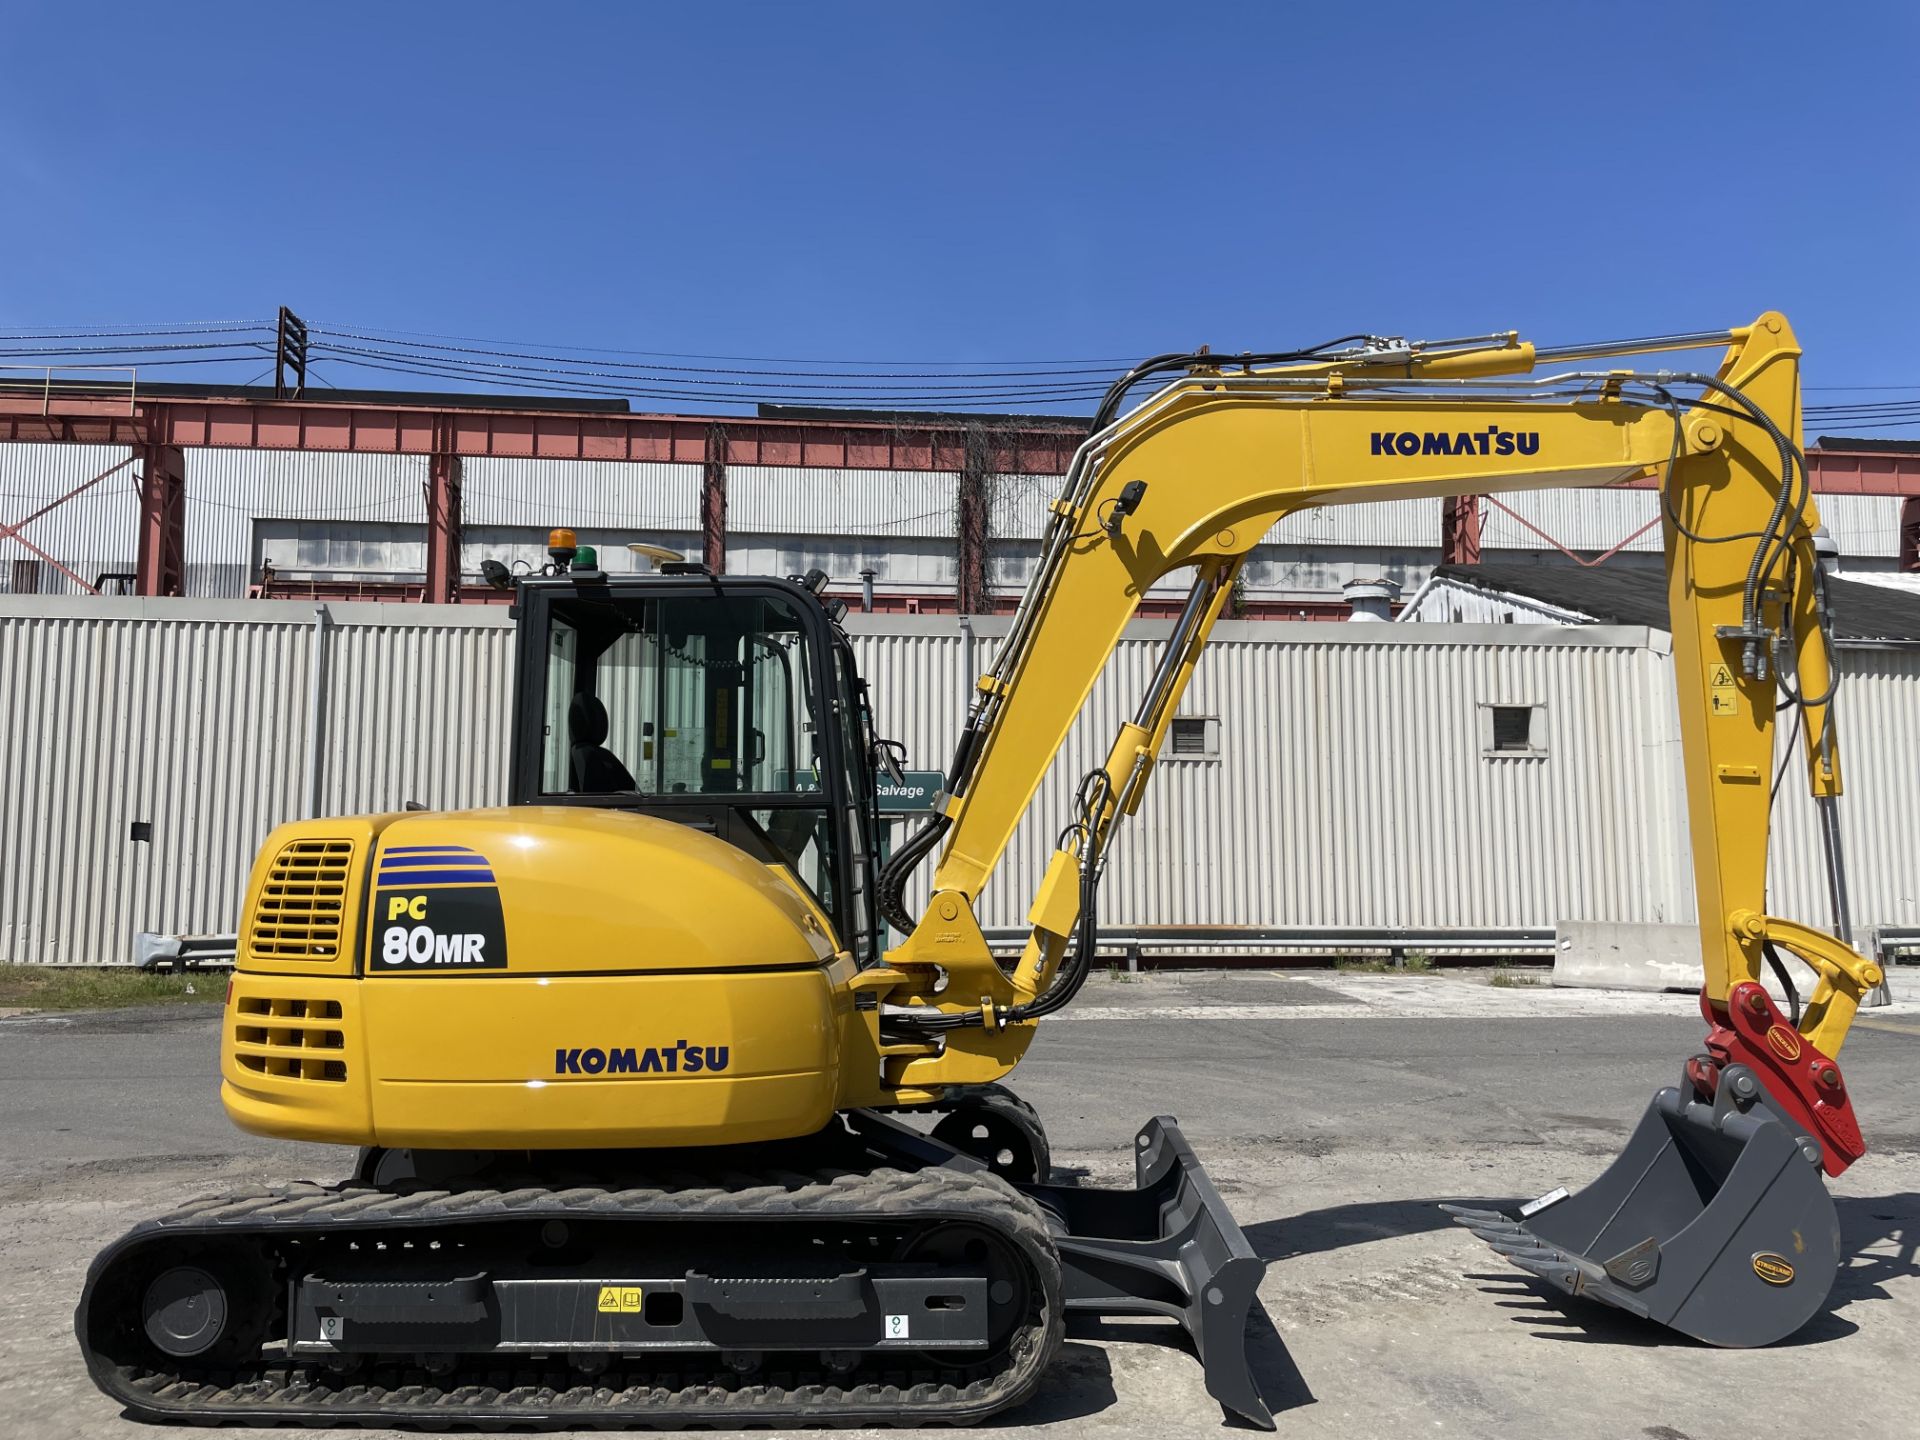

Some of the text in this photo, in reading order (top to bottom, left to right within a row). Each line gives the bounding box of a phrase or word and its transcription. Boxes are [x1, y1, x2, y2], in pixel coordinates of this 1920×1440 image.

[1370, 425, 1540, 456] KOMATSU
[876, 784, 925, 799] Salvage
[387, 895, 428, 921] PC
[382, 925, 486, 965] 80MR
[555, 1039, 729, 1075] KOMATSU
